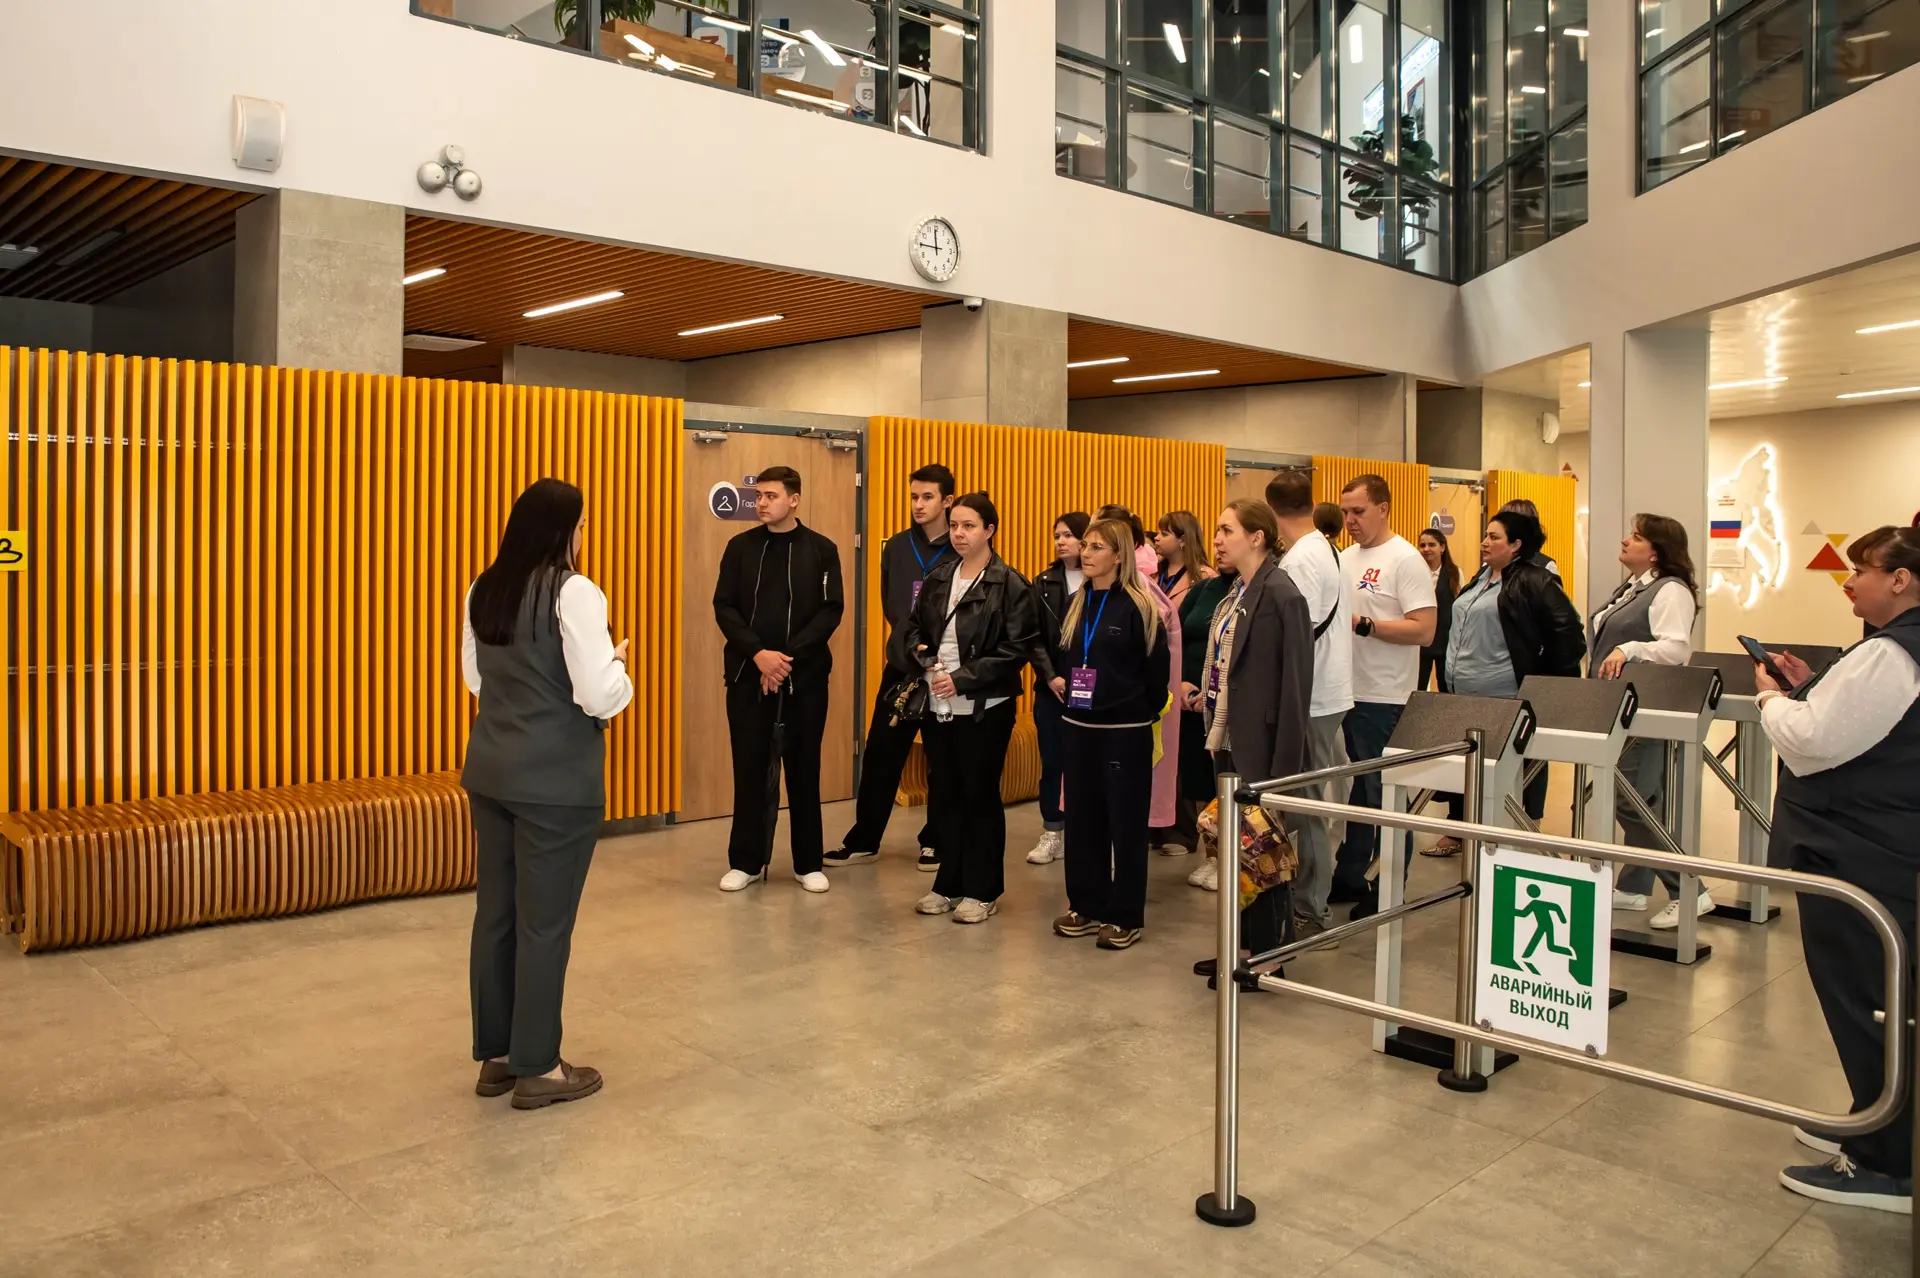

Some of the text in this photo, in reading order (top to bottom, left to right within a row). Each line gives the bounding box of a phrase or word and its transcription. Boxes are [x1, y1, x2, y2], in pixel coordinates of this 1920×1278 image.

[742, 500, 757, 508] Гар
[1363, 568, 1380, 582] 81
[1490, 973, 1592, 1011] АВАРИЙНЫЙ
[1510, 999, 1570, 1030] ВЫХОД
